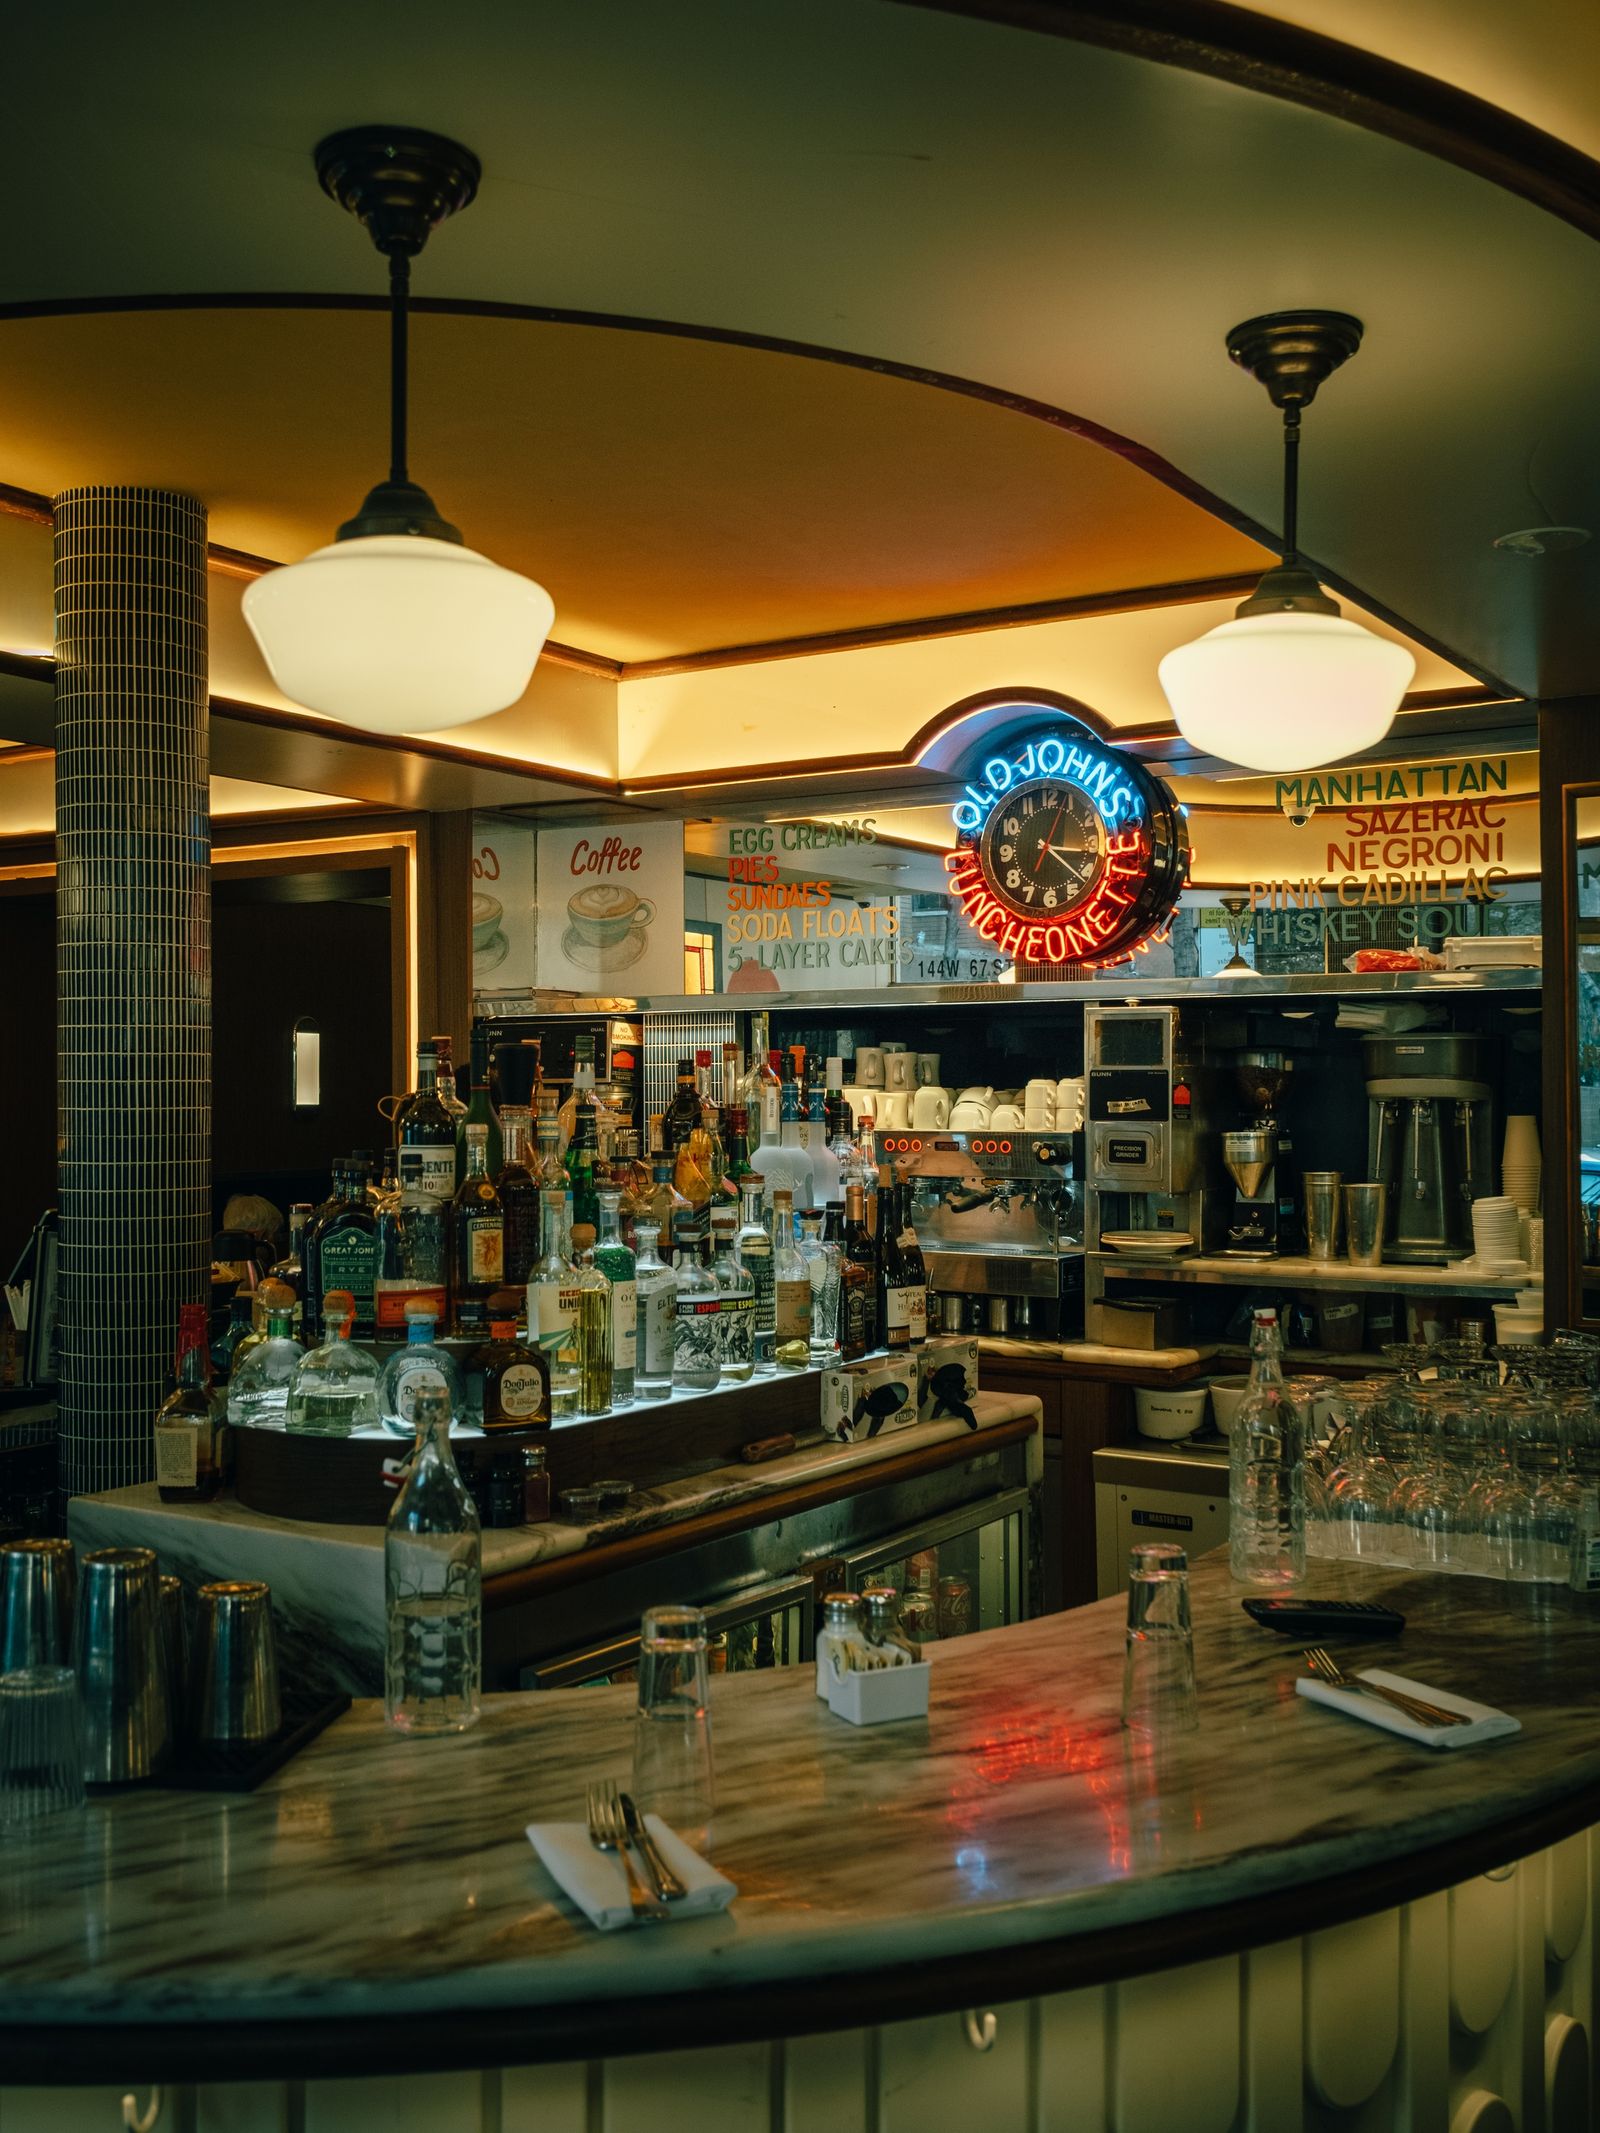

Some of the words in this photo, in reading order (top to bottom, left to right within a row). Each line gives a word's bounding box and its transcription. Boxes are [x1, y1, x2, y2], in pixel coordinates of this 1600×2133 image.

[952, 758, 1011, 830] OLD
[1042, 789, 1058, 808] 12
[1275, 760, 1507, 810] MANHATTAN
[1022, 797, 1034, 816] 11
[1084, 810, 1095, 828] 2
[1345, 796, 1506, 837] SAZERAC
[729, 826, 774, 855] EGG
[780, 818, 877, 851] CREAMS
[1003, 817, 1019, 836] 10
[570, 836, 643, 876] Coffee
[999, 844, 1014, 863] 9
[1087, 835, 1099, 854] 3
[1327, 832, 1504, 872] NEGRONI
[728, 855, 780, 883] PIES
[1006, 869, 1021, 889] 8
[727, 881, 832, 912] SUNDAES
[944, 831, 1141, 963] LUNCHEONETTE
[1022, 886, 1036, 904] 7
[1043, 890, 1058, 909] 6
[1067, 883, 1080, 901] 5
[1249, 877, 1326, 912] PINK
[1337, 866, 1509, 907] CADILLAC
[726, 911, 793, 943] SODA
[803, 906, 900, 938] FLOATS
[1226, 908, 1382, 946] WHISKEY
[1396, 904, 1509, 939] SOUR
[838, 936, 915, 967] CAKES
[918, 959, 960, 978] 144W
[324, 1247, 352, 1255] GREAT
